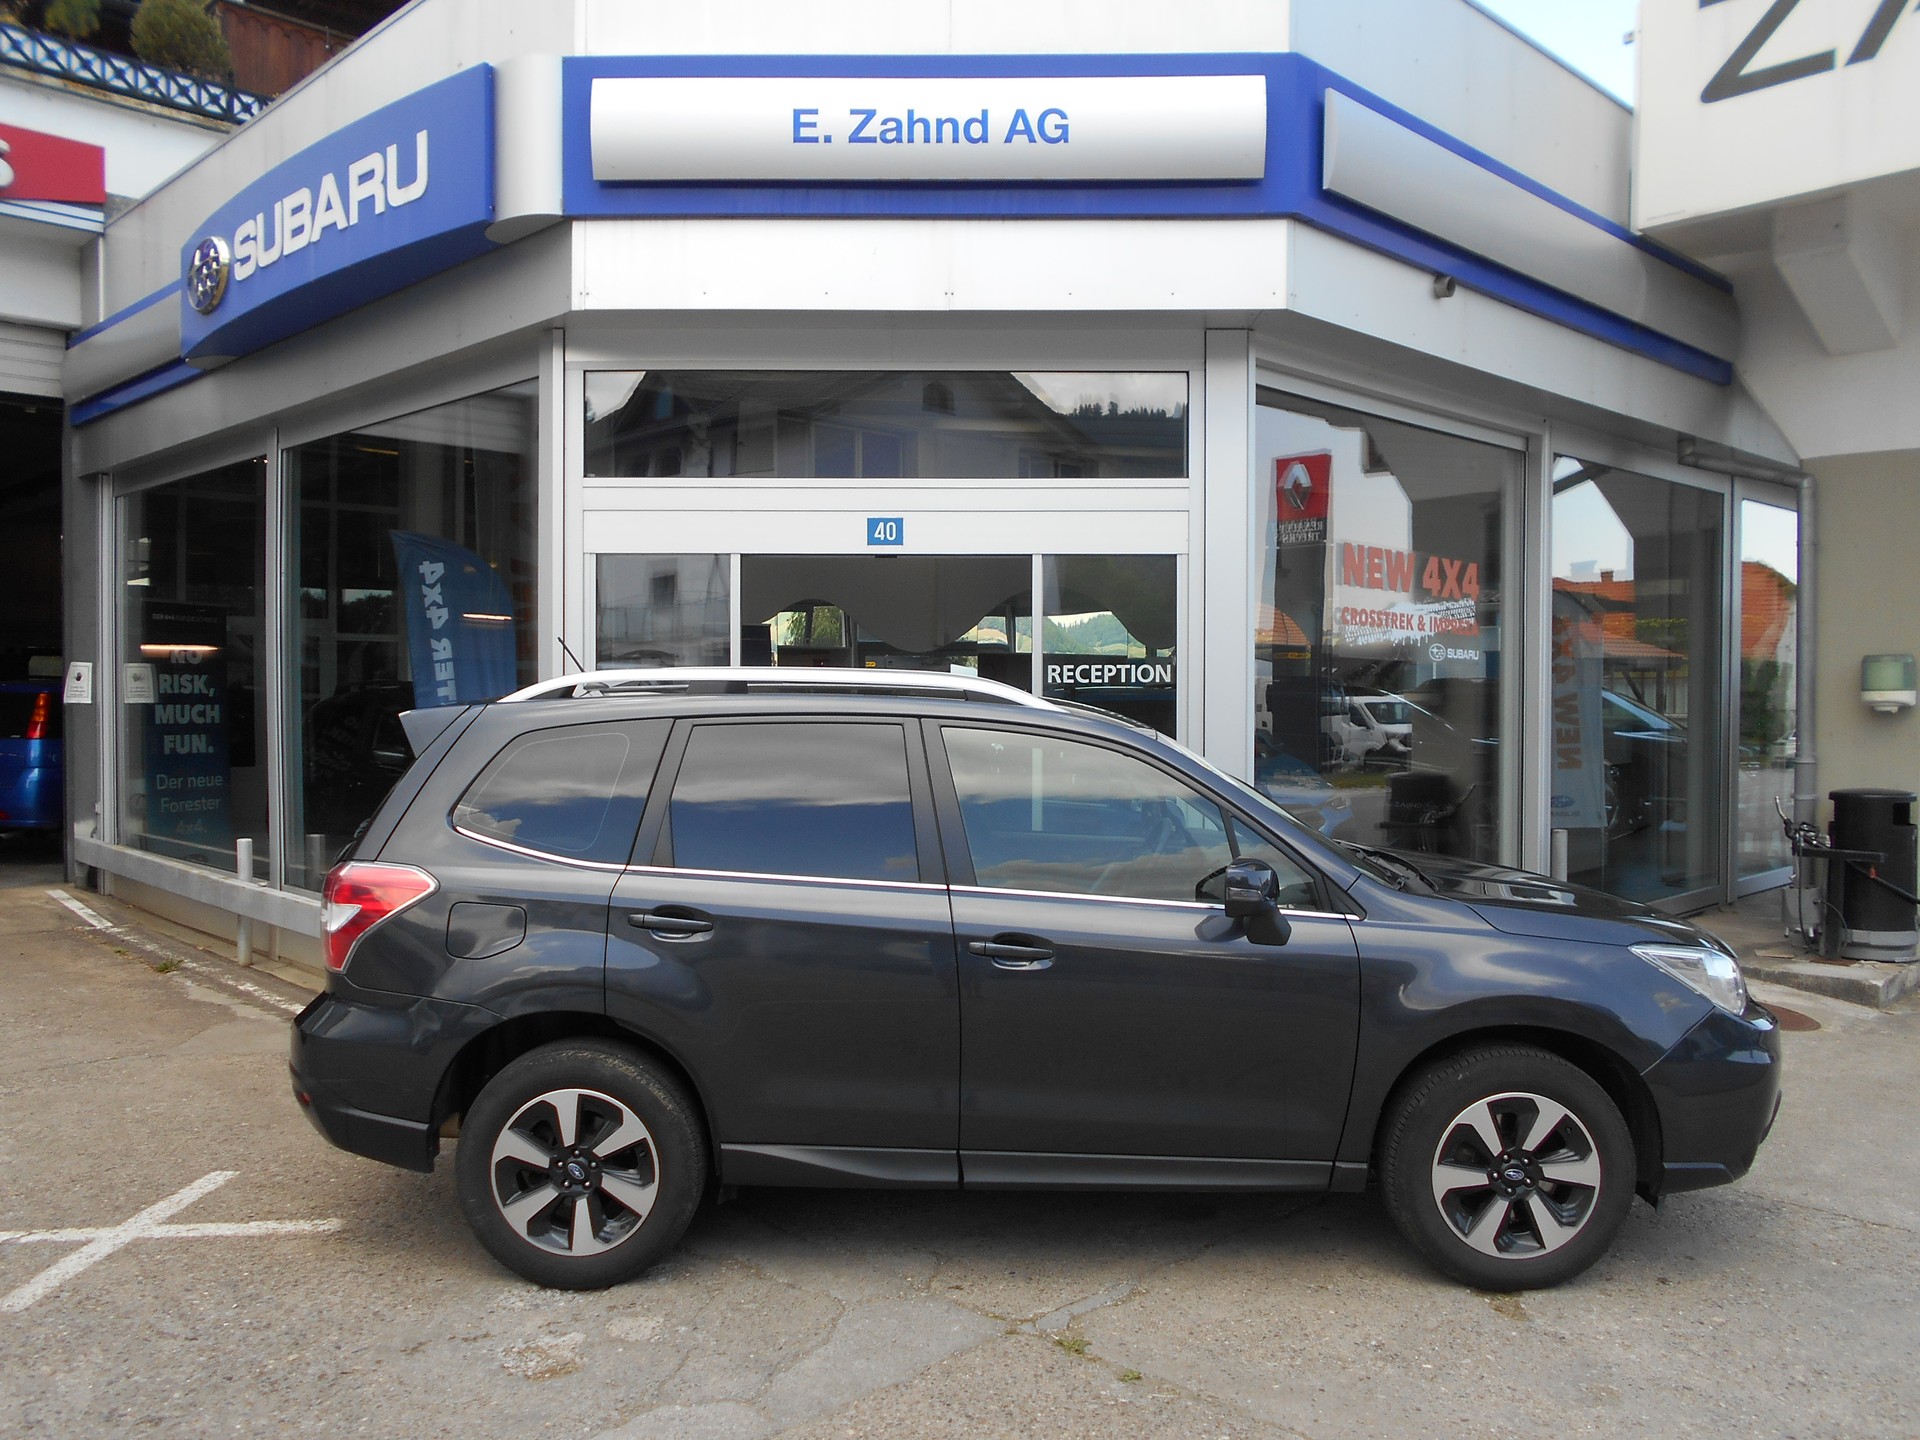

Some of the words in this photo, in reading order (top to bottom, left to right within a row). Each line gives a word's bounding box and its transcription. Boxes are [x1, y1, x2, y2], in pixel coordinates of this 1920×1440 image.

[793, 108, 832, 144] E.
[848, 108, 989, 144] Zahnd
[1003, 107, 1069, 144] AG
[233, 129, 429, 282] SUBARU
[874, 521, 897, 541] 40
[1343, 542, 1416, 593] NEW
[1422, 555, 1480, 601] 4X4
[1341, 606, 1414, 632] CROSSTREK
[1417, 615, 1427, 633] &
[1447, 648, 1479, 660] SUBARU
[1047, 664, 1172, 684] RECEPTION
[158, 673, 216, 697] RISK,
[154, 703, 221, 725] MUCH
[163, 734, 214, 755] FUN.
[156, 774, 183, 789] Der
[187, 774, 223, 788] neue
[160, 797, 221, 812] Forester
